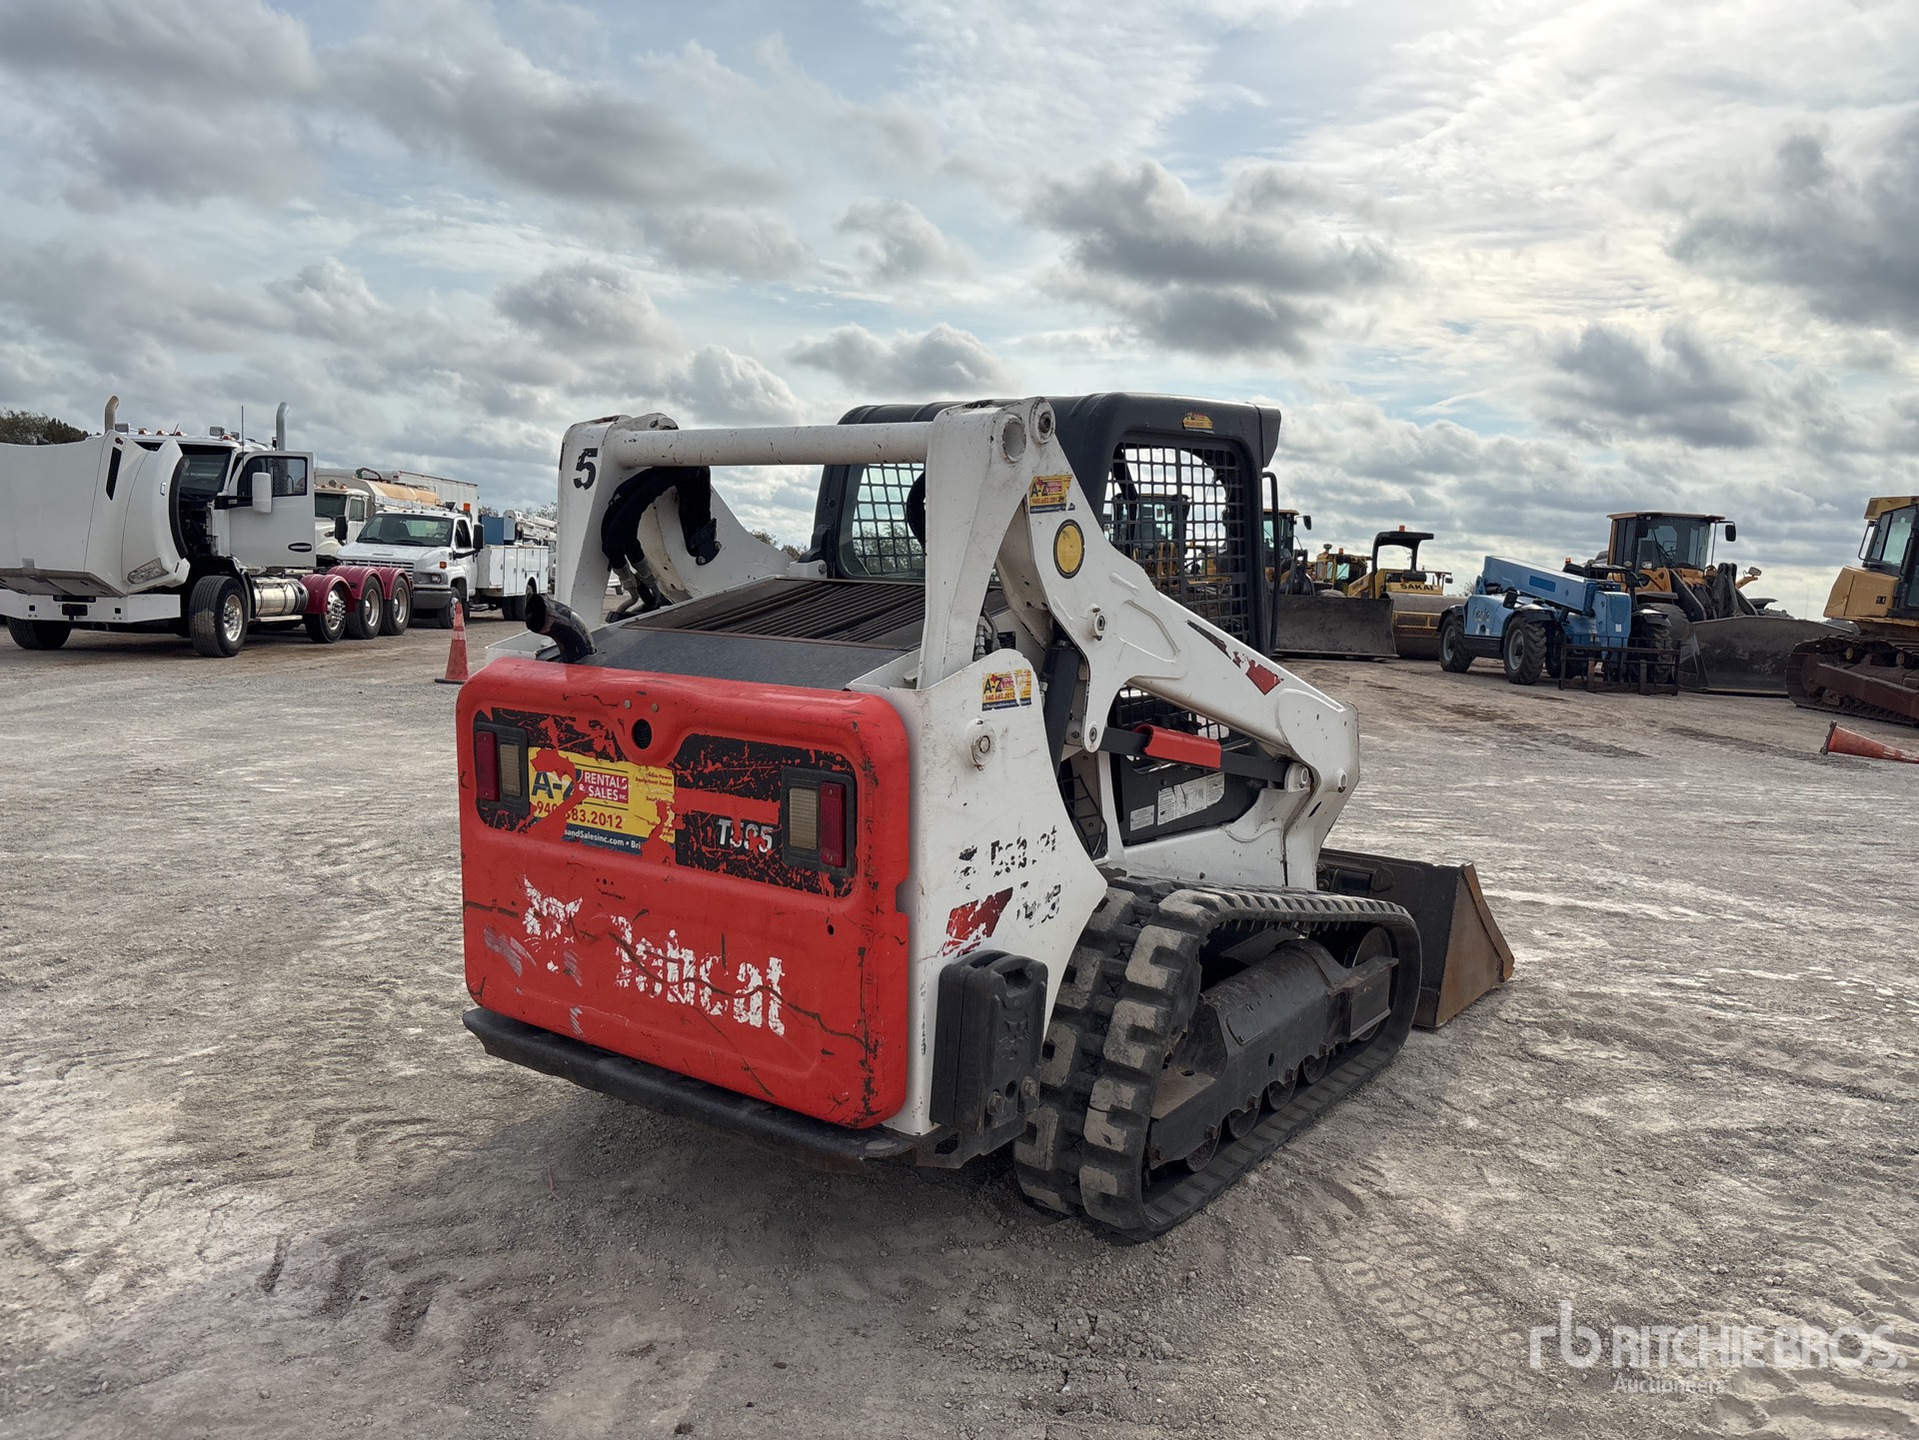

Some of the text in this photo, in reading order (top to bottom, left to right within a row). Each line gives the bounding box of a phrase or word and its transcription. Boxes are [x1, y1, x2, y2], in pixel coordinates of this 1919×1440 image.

[573, 447, 598, 490] 5
[1400, 583, 1434, 591] SAKAI
[584, 771, 628, 790] RENTALS
[588, 785, 619, 801] SALES
